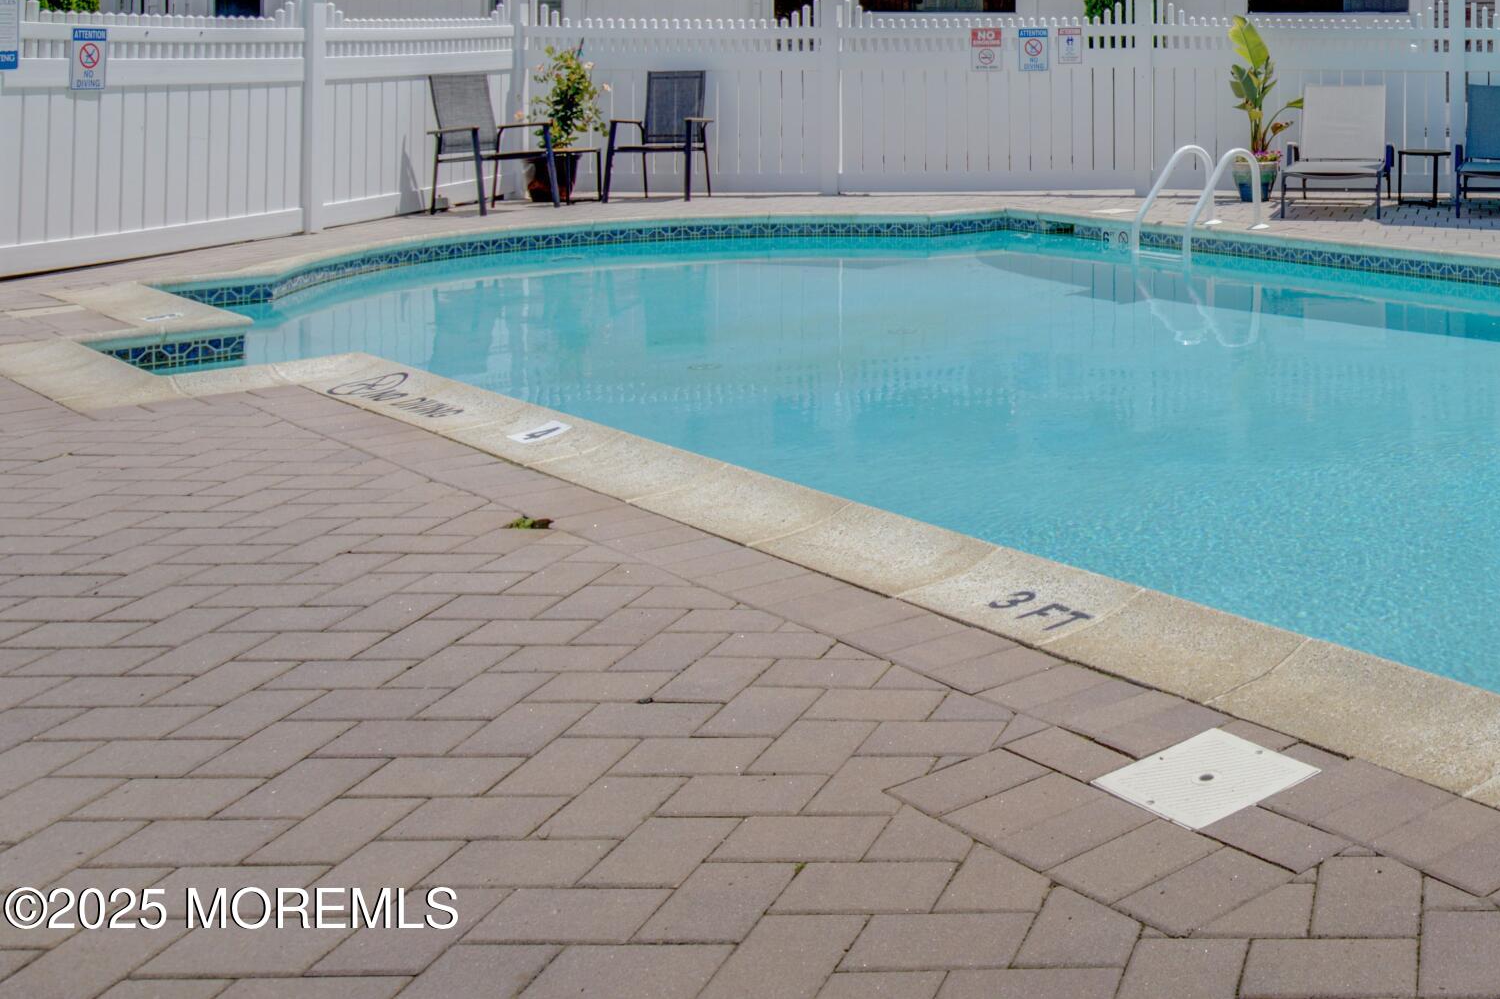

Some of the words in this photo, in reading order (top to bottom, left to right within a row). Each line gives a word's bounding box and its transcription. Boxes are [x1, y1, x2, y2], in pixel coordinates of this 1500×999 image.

[74, 30, 106, 39] ATTENTION
[977, 30, 995, 40] NO
[84, 70, 93, 78] NO
[76, 79, 101, 88] DIVING
[988, 591, 1036, 609] 3
[1014, 603, 1096, 631] FT
